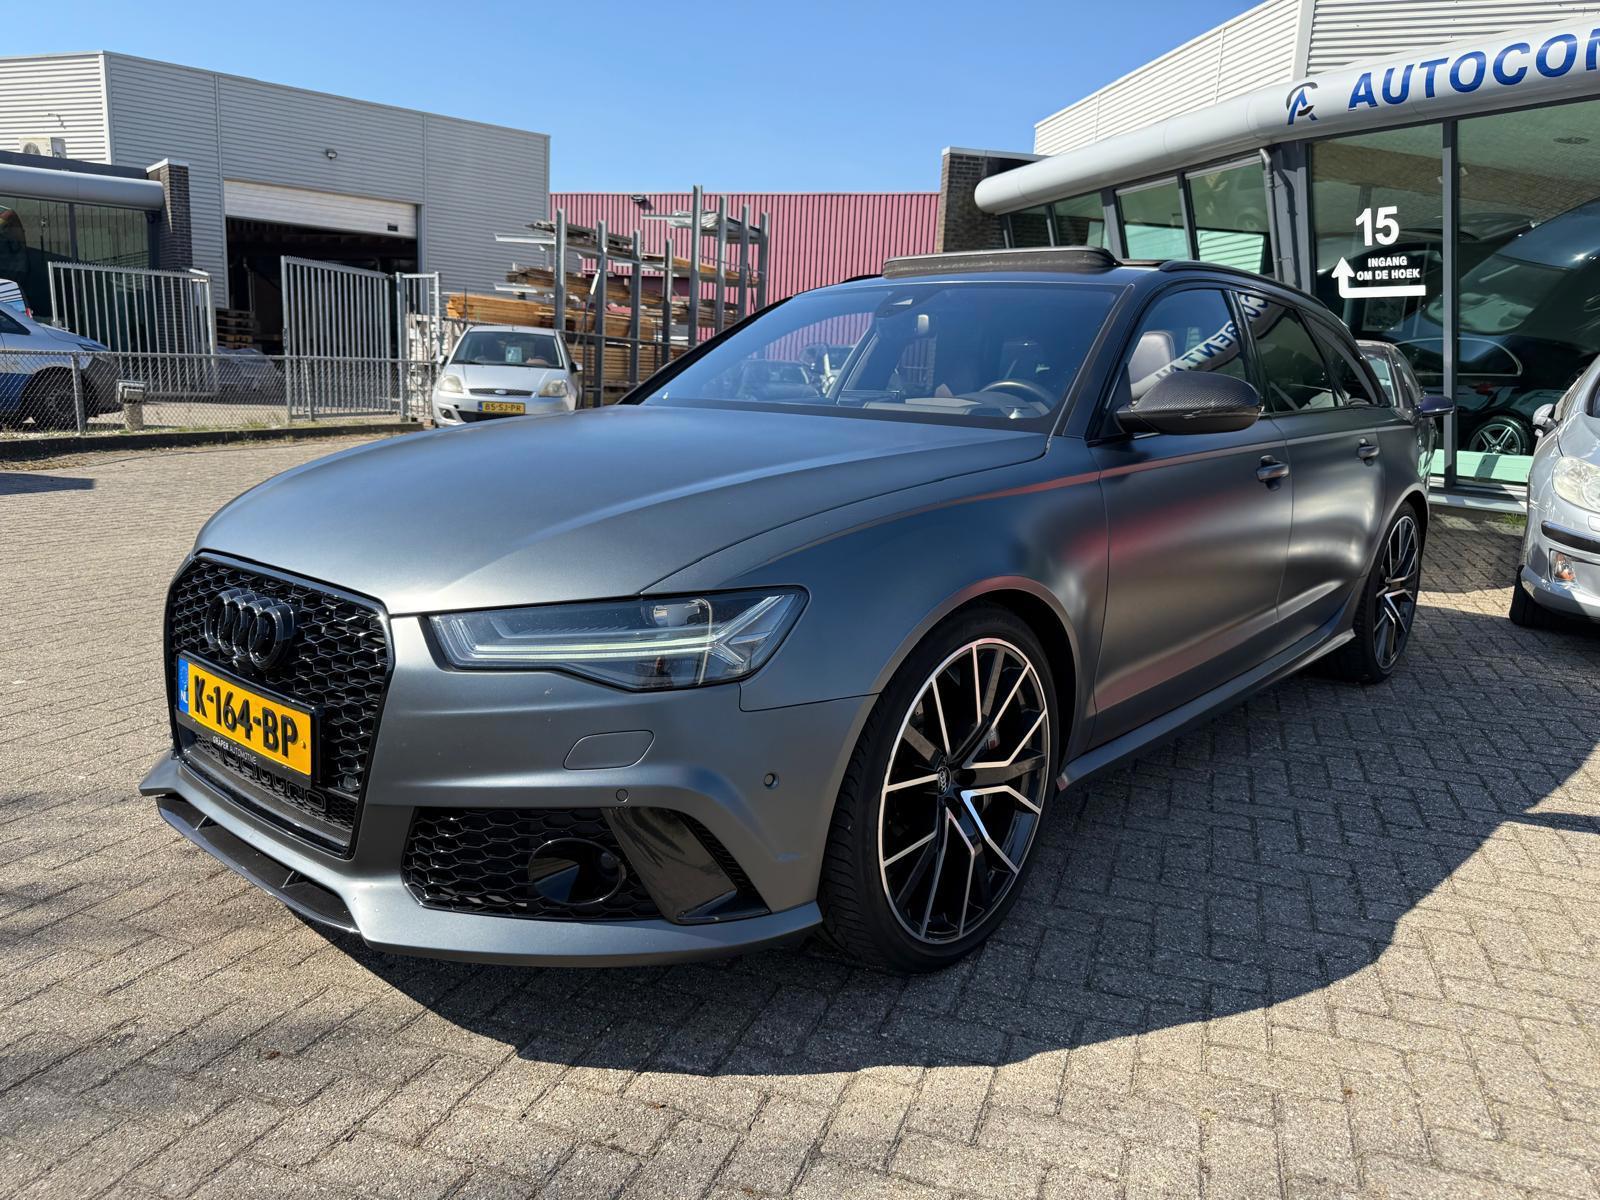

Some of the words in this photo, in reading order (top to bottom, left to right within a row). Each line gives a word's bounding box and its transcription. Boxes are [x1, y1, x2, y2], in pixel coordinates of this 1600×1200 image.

[1355, 206, 1400, 247] 15
[1367, 256, 1408, 268] INGANG
[1356, 270, 1373, 281] OM
[1374, 269, 1389, 280] DE
[1391, 268, 1420, 279] HOEK
[484, 402, 522, 412] 85-SJ-PR
[194, 675, 298, 758] K-164-BP
